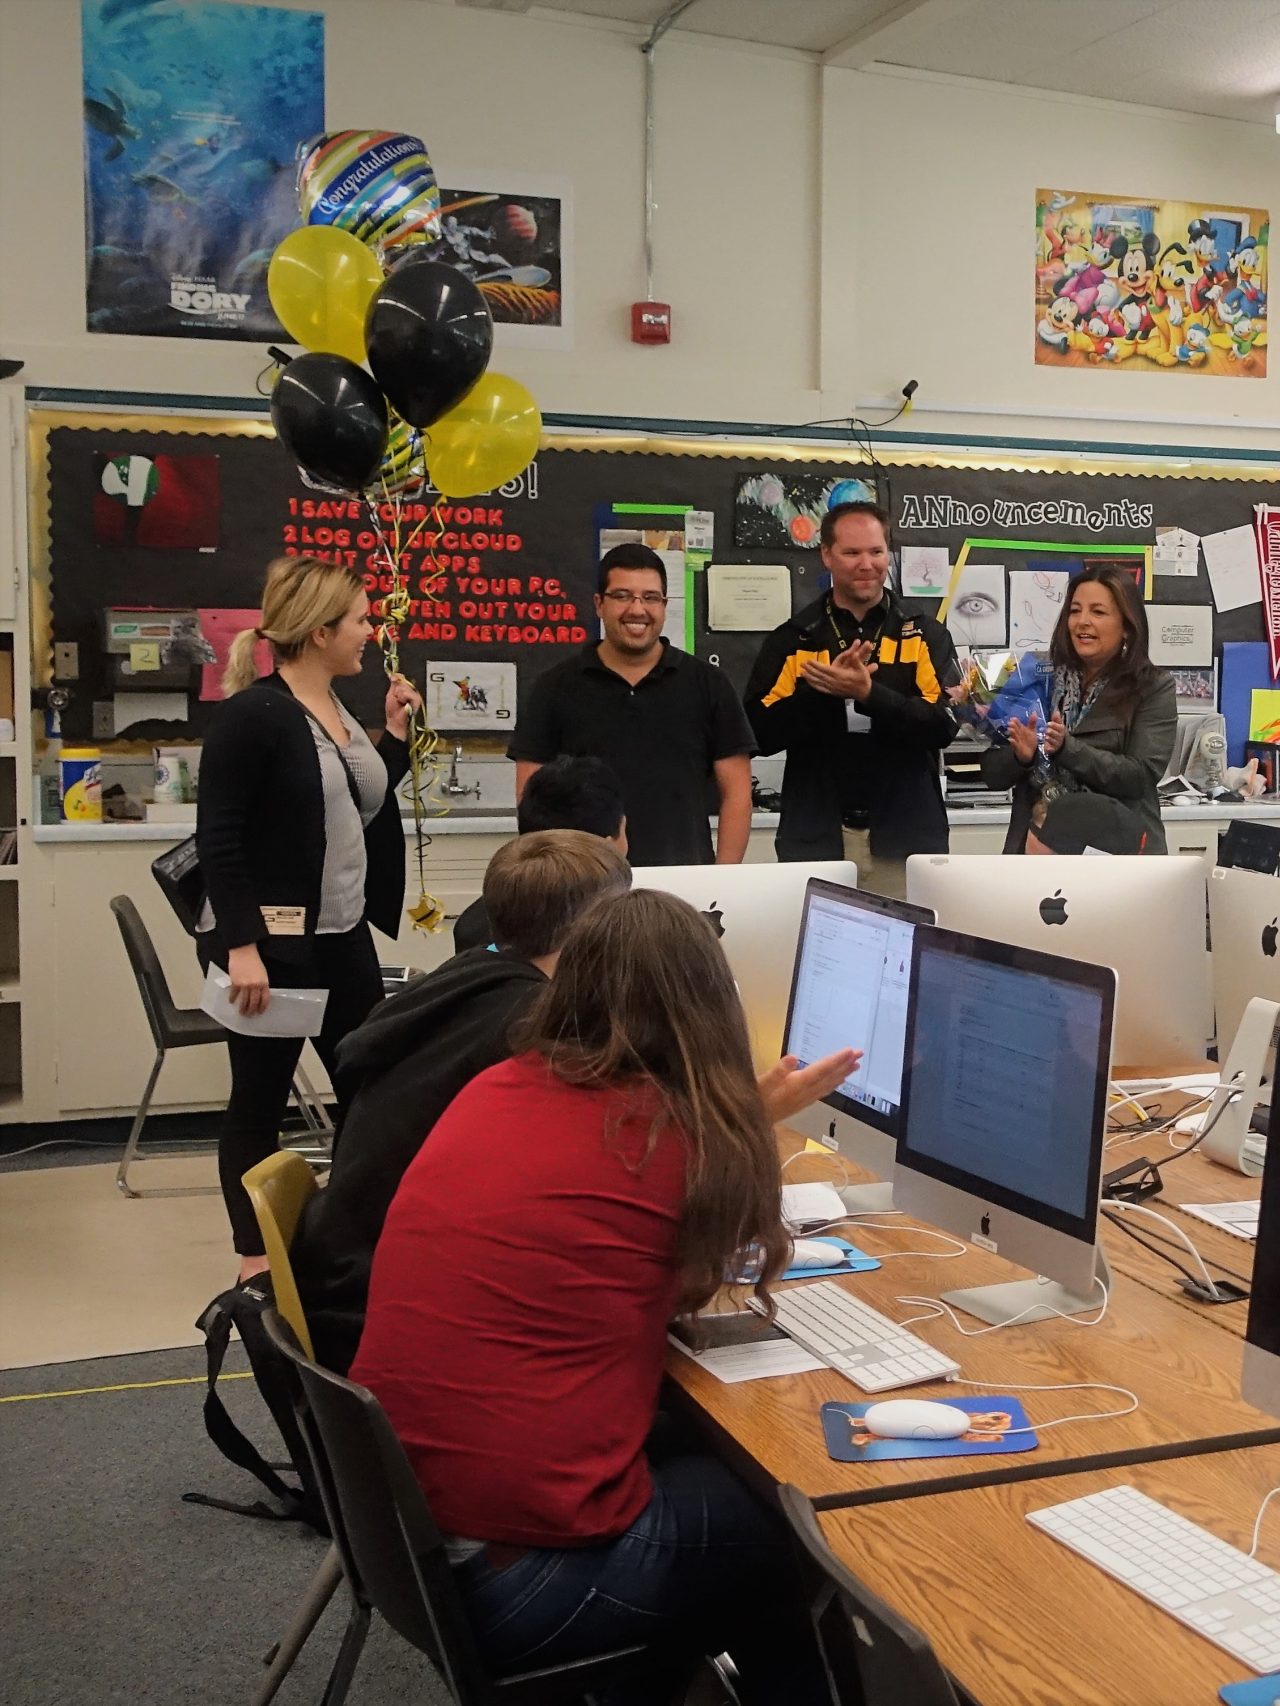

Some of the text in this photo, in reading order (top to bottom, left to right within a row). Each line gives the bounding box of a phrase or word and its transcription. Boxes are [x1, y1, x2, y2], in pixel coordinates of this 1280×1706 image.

[170, 290, 251, 312] DORY
[288, 498, 298, 516] 1
[301, 500, 361, 520] SAVE
[430, 505, 504, 526] WORK
[283, 525, 298, 543] 2
[301, 526, 352, 547] LOG
[441, 532, 523, 552] CLOUD
[420, 553, 480, 574] APPS
[419, 576, 449, 594] OF
[456, 577, 522, 596] YOUR
[459, 600, 509, 620] OUT
[513, 602, 577, 621] YOUR
[408, 622, 457, 641] AND
[465, 624, 587, 643] KEYBOARD
